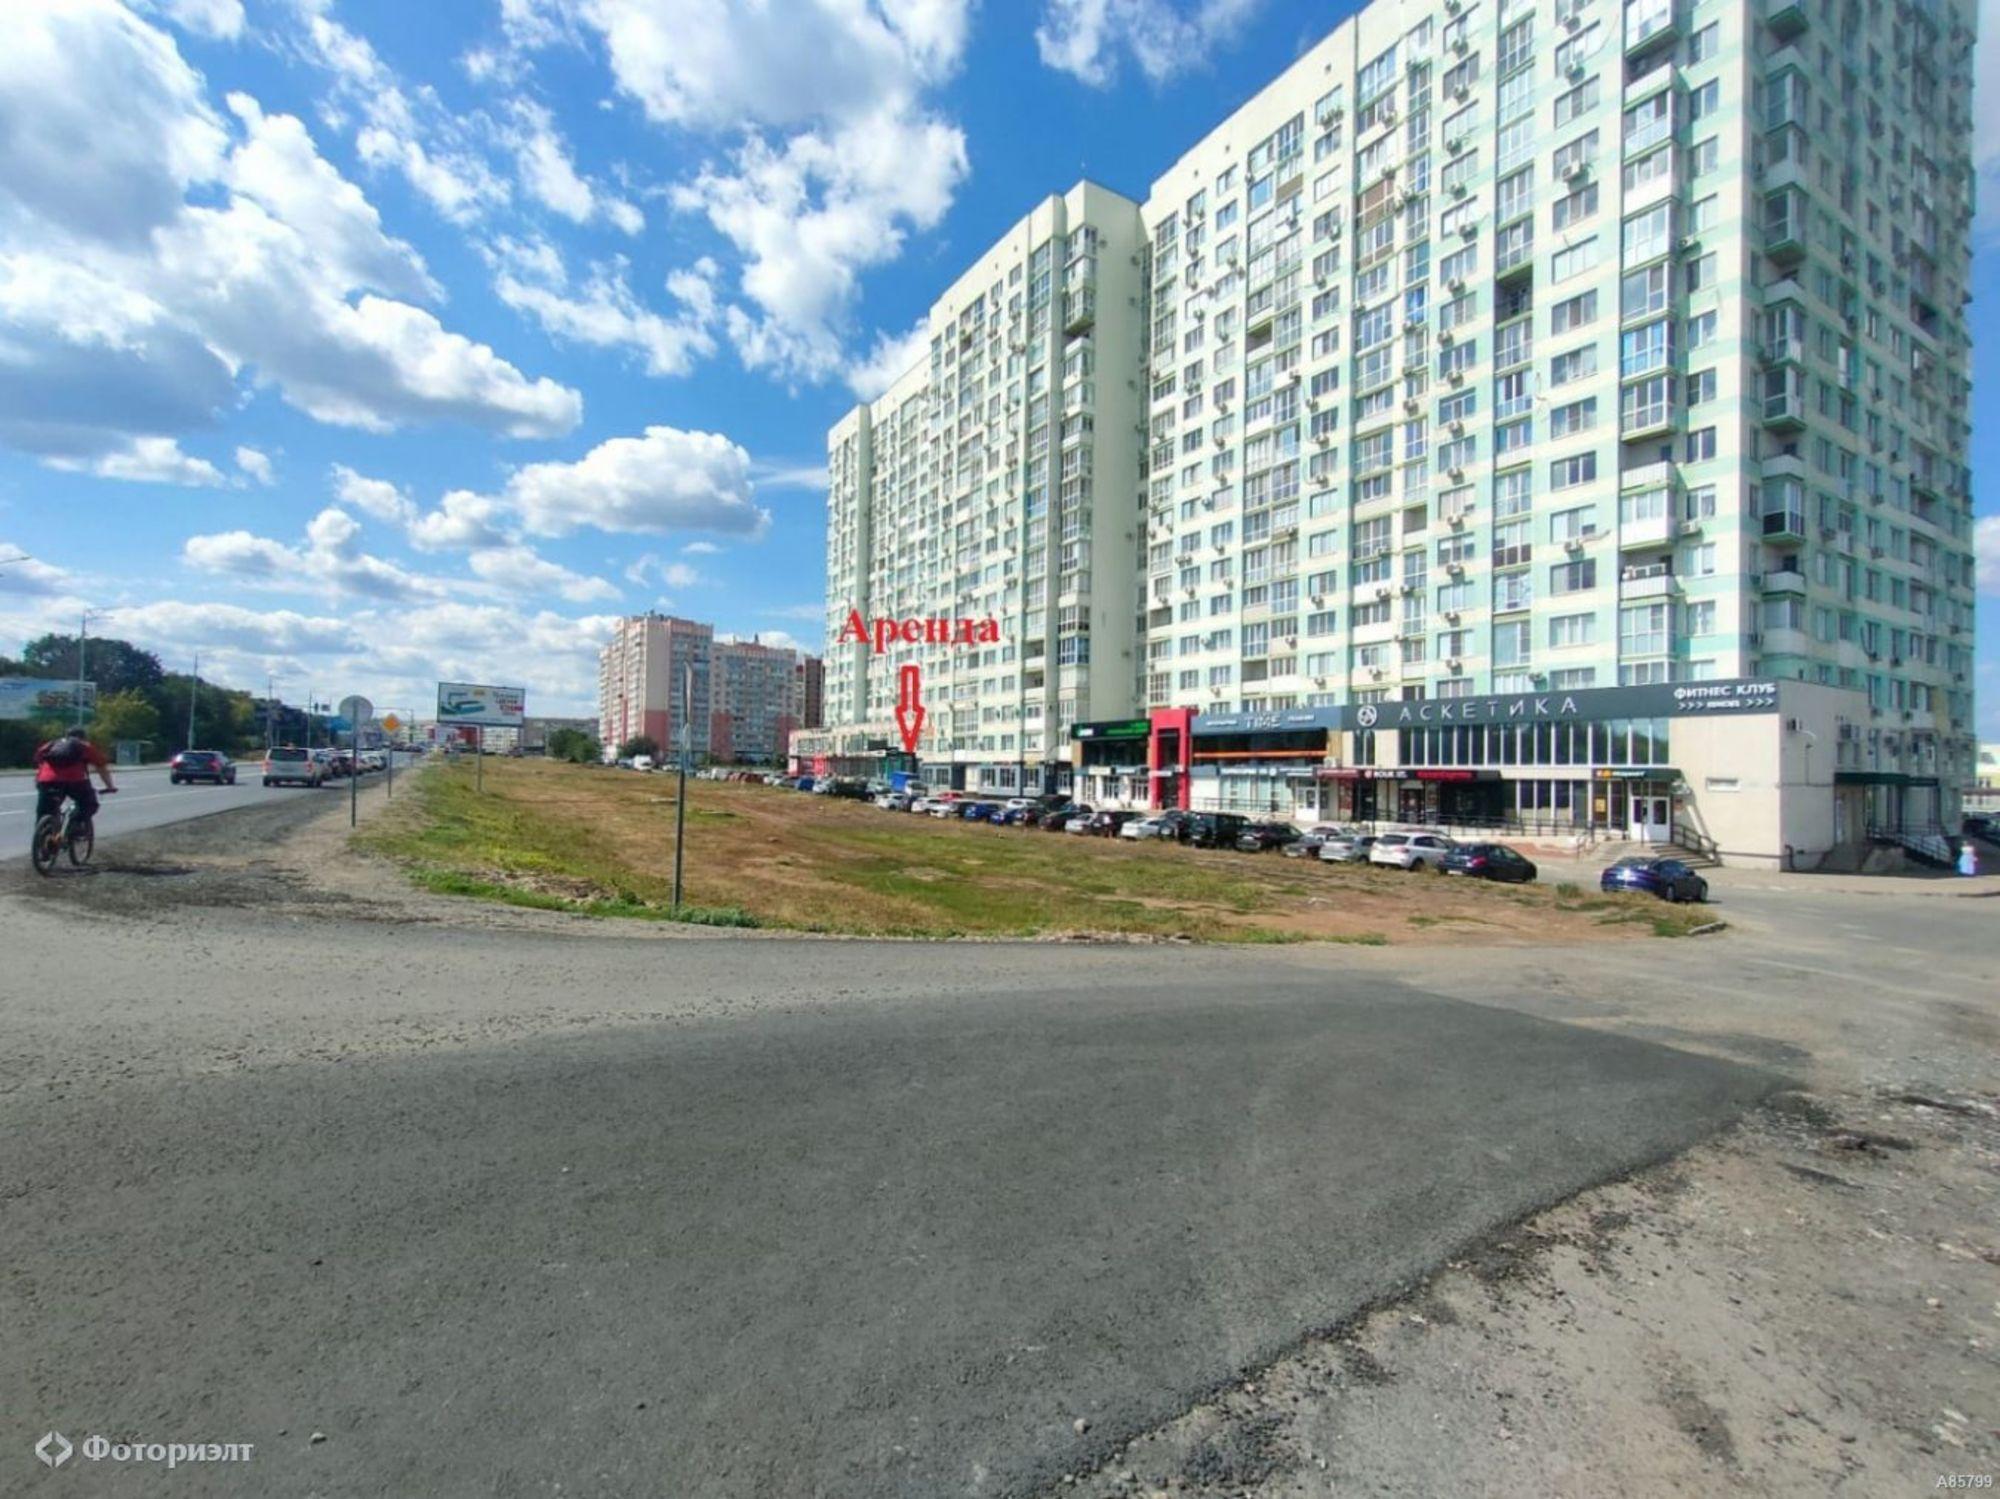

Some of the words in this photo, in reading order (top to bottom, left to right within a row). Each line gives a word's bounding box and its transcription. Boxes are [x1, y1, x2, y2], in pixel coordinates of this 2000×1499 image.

[1674, 685, 1732, 700] ФИТНЕС
[1736, 682, 1777, 697] КЛУБ
[1398, 696, 1578, 722] АСКЕТИКА
